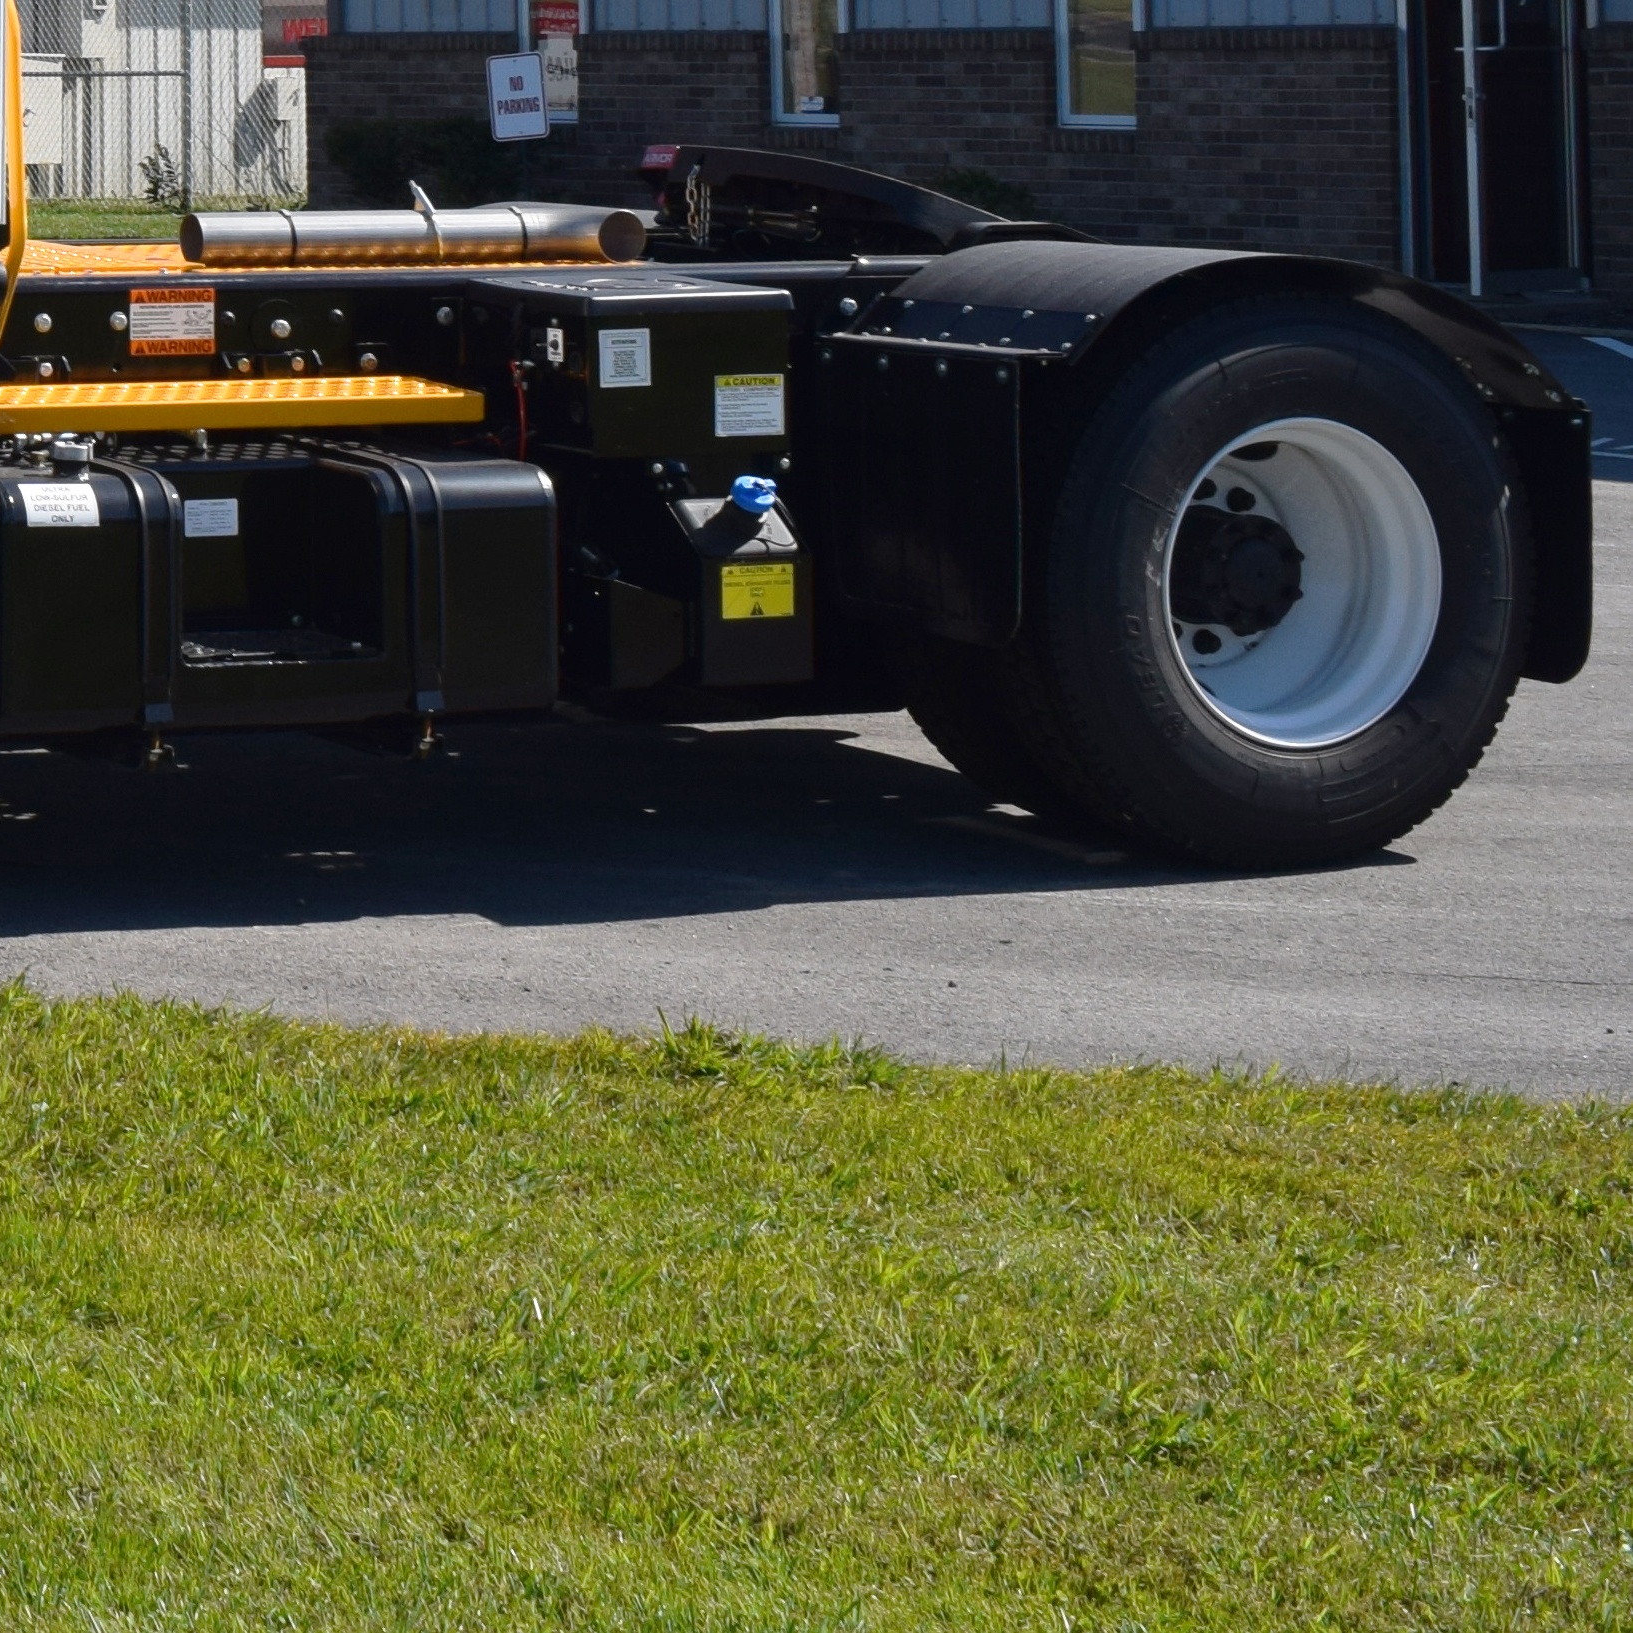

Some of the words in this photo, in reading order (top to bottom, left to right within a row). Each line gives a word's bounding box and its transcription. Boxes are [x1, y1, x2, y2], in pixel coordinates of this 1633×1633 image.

[509, 76, 524, 92] NO
[497, 97, 540, 116] PARKING
[147, 290, 212, 302] WARNING
[147, 340, 212, 354] WARNING
[732, 377, 775, 386] CAUTION
[33, 504, 65, 512] DIESEL
[67, 504, 90, 512] FUEL
[51, 515, 75, 523] ONLY
